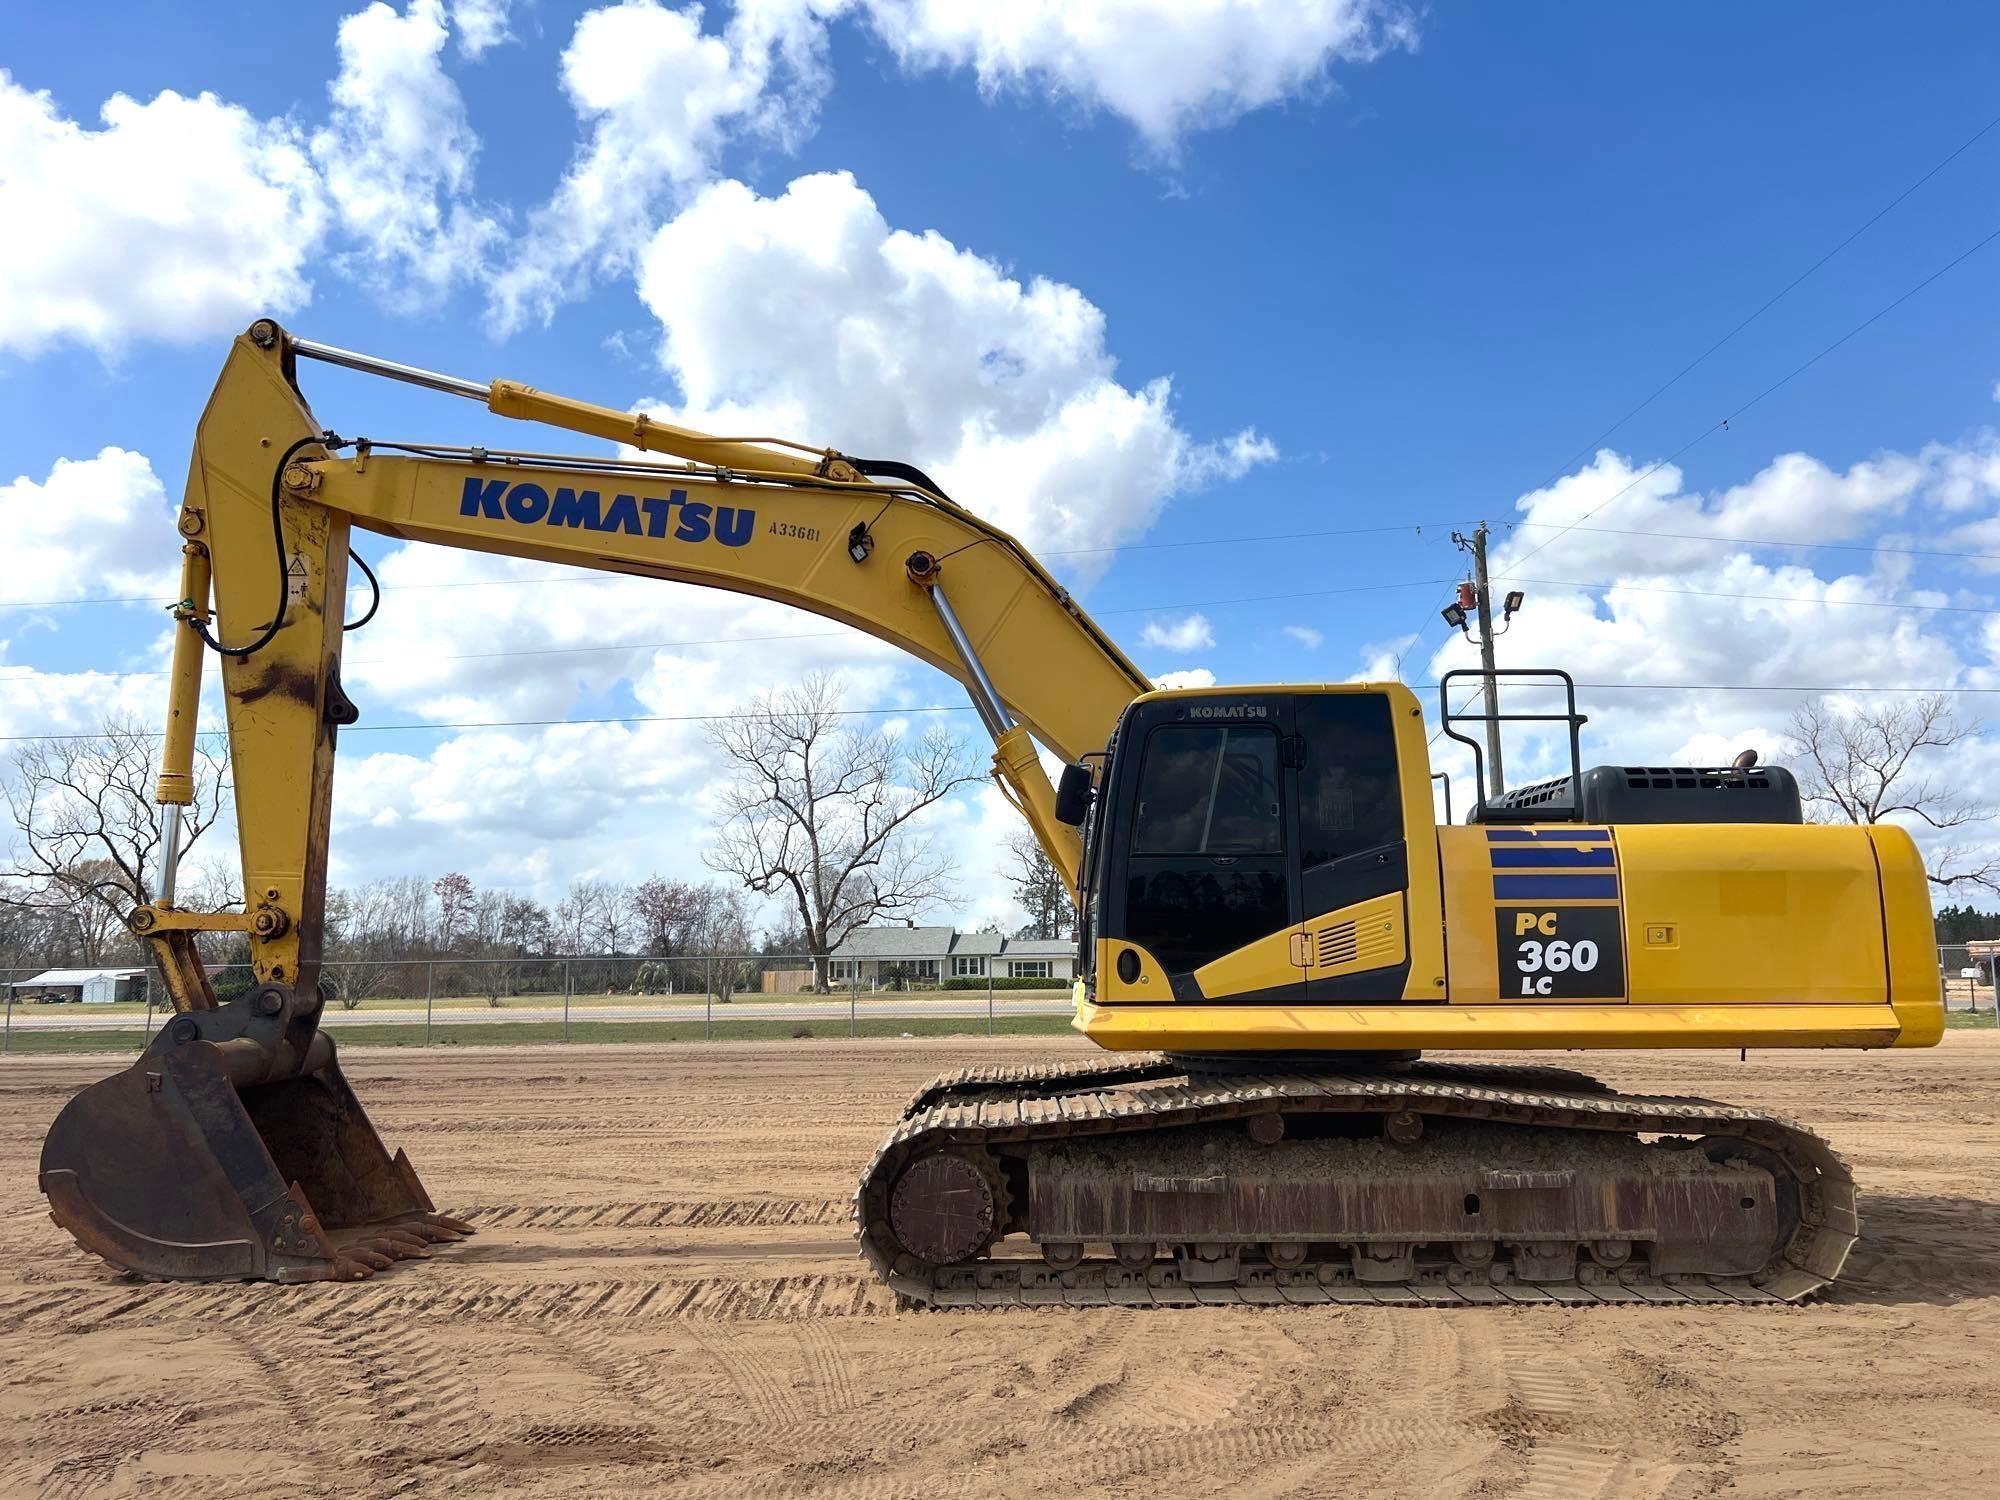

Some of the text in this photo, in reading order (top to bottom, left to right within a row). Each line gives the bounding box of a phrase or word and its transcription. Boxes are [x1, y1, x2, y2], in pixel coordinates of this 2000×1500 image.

[459, 477, 756, 547] KOMATSU
[1190, 704, 1267, 718] KOMATSU
[1515, 912, 1557, 936] PC
[1517, 940, 1599, 973] 360
[1521, 976, 1553, 995] LC
